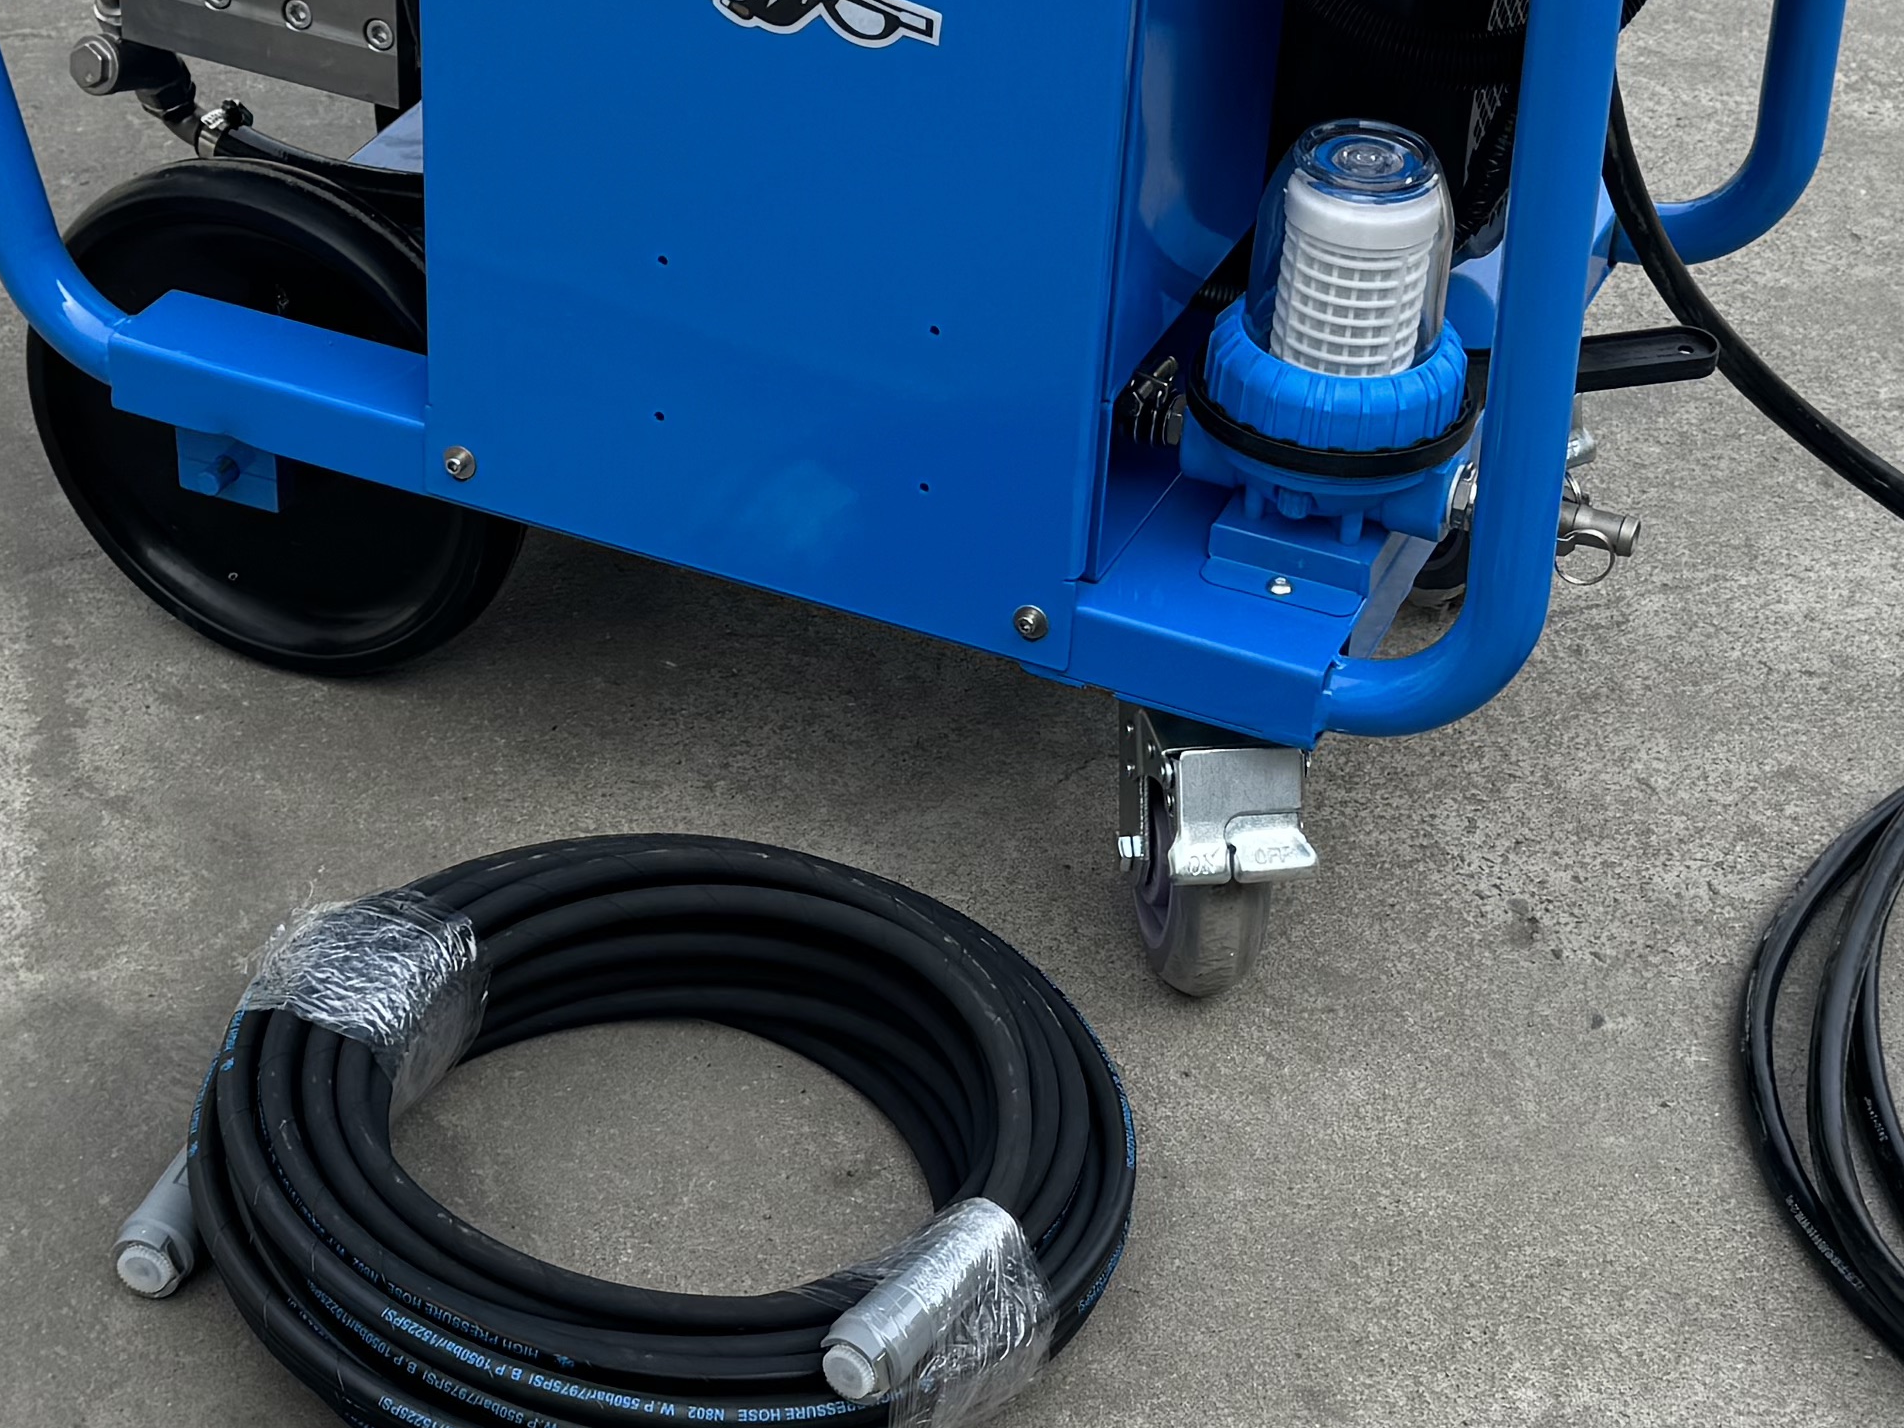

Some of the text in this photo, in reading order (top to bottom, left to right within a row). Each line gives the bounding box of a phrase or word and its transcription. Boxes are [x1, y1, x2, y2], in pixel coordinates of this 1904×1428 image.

[387, 1281, 422, 1310] HOSE
[424, 1301, 498, 1345] PRESSURE
[502, 1334, 539, 1359] HIGH
[393, 1355, 418, 1375] B.P
[495, 1363, 524, 1382] B.P
[528, 1371, 641, 1412] 550bar/7975PSI
[644, 1400, 675, 1417] W.P
[688, 1405, 725, 1422] N802
[737, 1407, 781, 1422] HOSE
